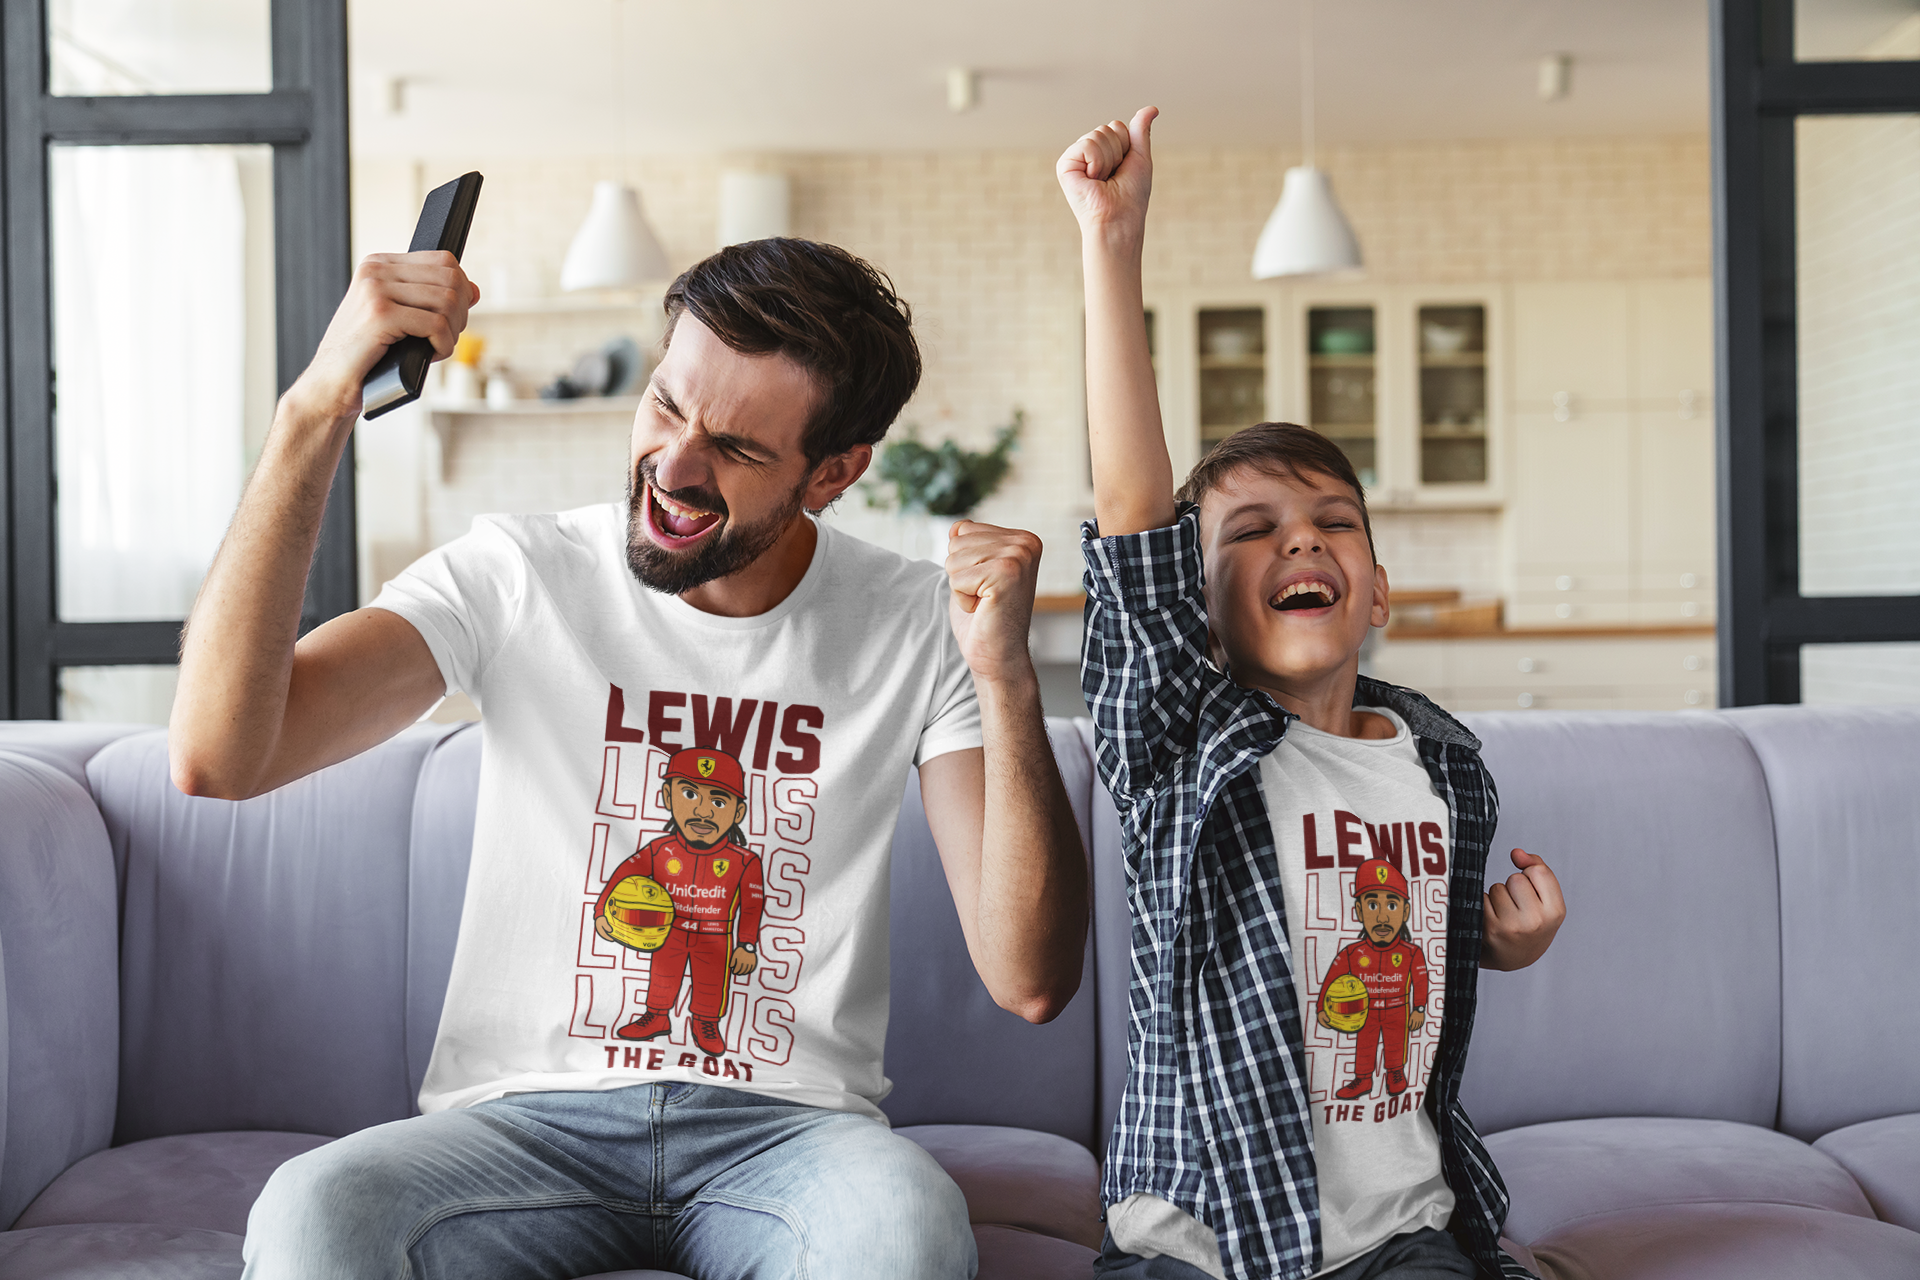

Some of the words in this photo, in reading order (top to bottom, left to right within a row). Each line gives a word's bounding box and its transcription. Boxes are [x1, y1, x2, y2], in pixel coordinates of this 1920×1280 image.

[604, 682, 824, 774] LEWIS
[1302, 809, 1447, 878] LEWIS
[665, 882, 727, 899] UniCredit
[681, 921, 697, 930] 44
[1359, 973, 1402, 982] UniCredit
[604, 1046, 665, 1070] THE
[678, 1052, 753, 1082] GOAT
[1324, 1105, 1365, 1125] THE
[1373, 1091, 1424, 1123] GOAT
